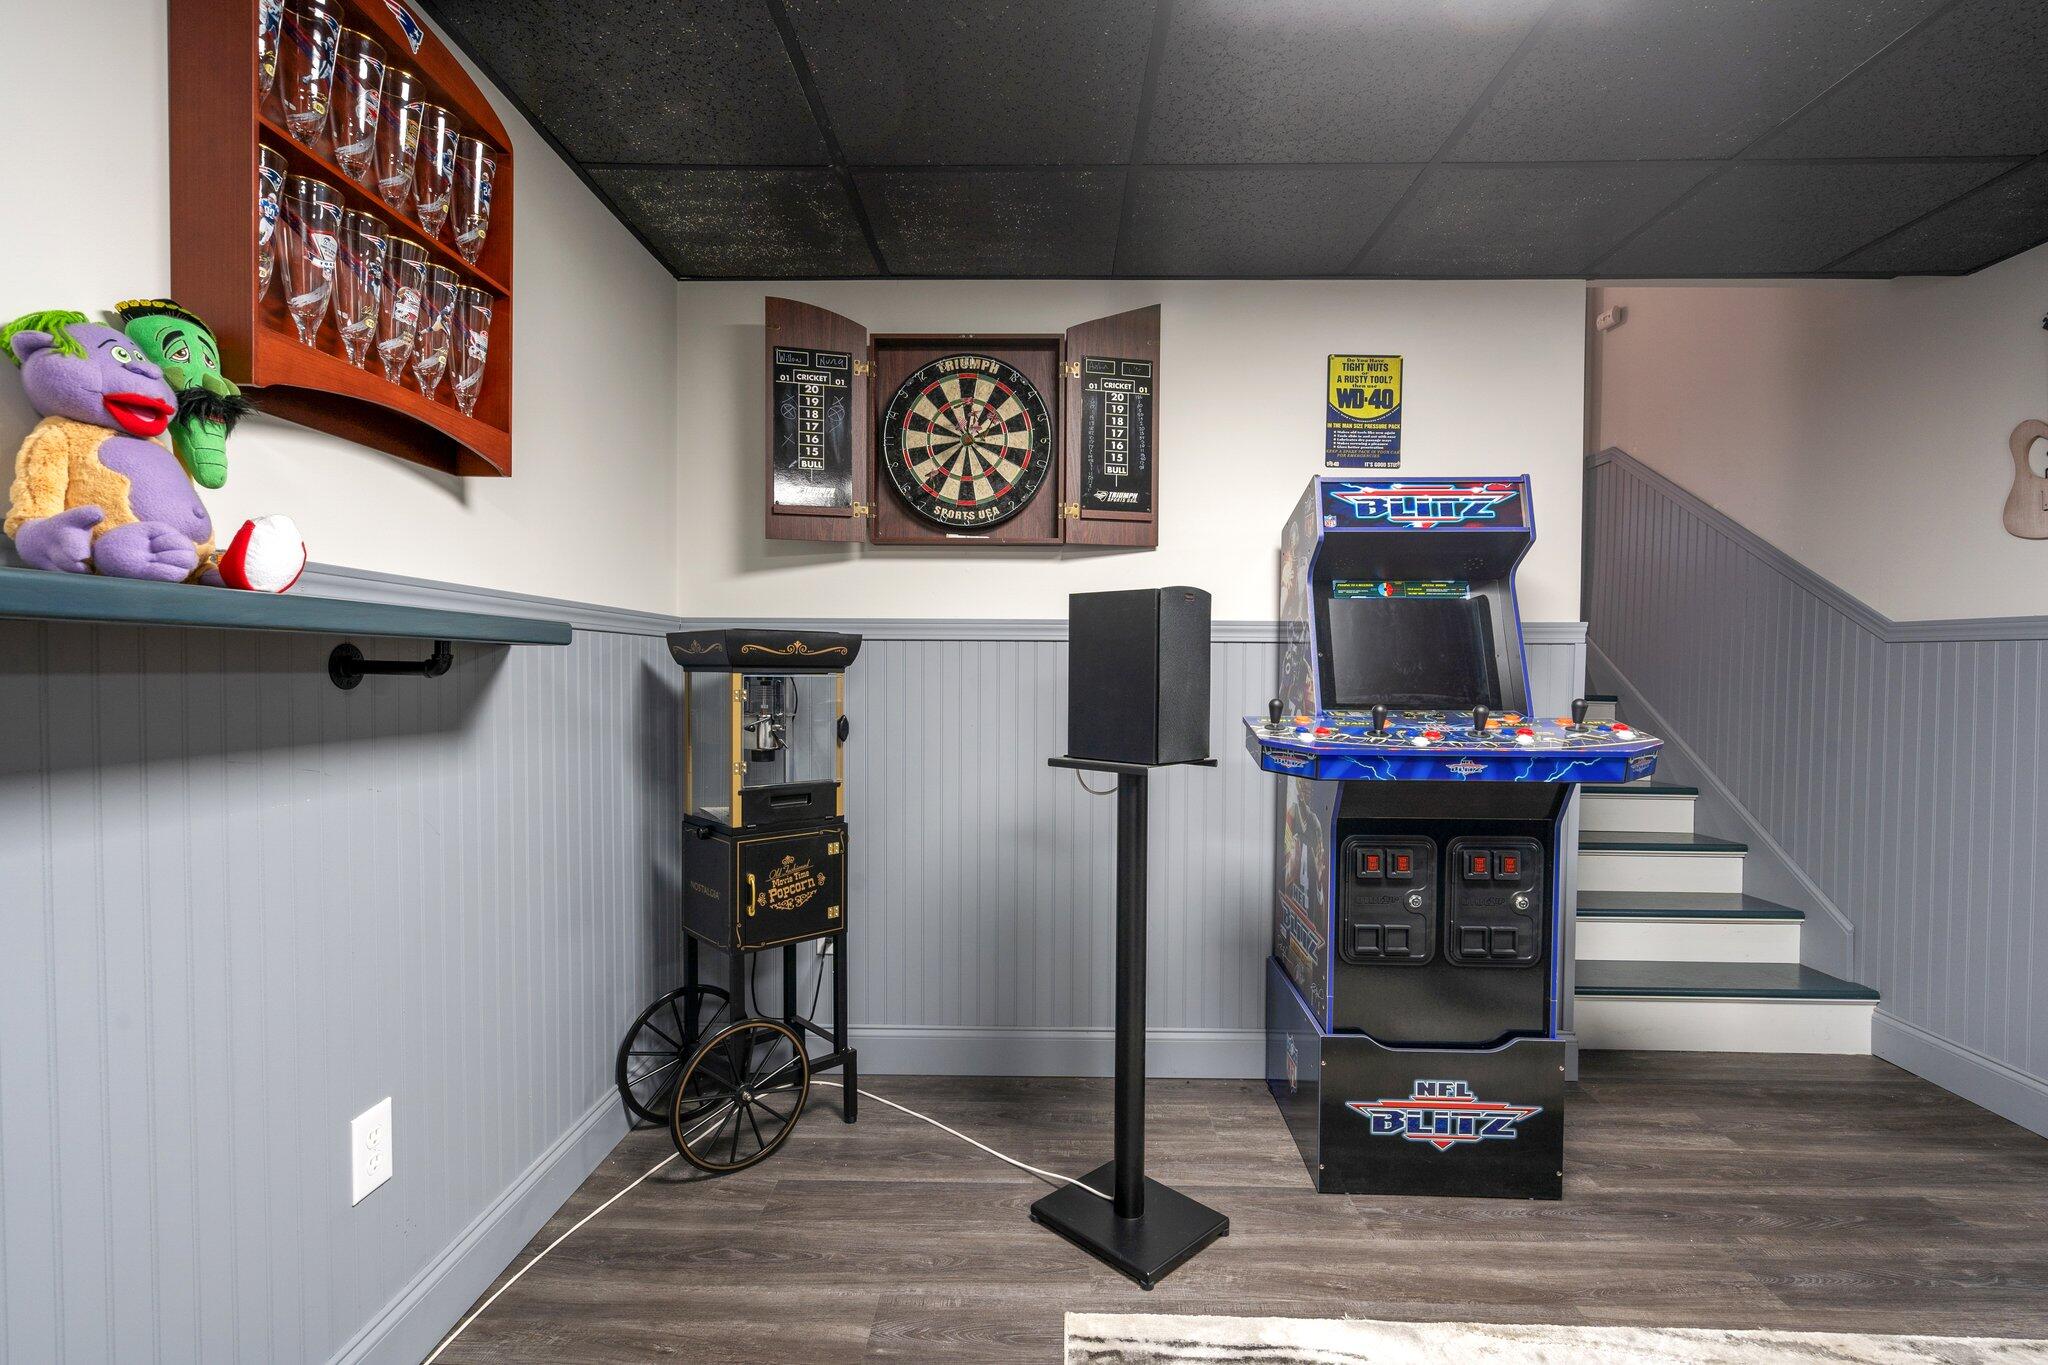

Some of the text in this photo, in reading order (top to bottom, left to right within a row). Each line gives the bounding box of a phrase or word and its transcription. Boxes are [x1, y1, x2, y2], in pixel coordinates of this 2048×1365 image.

[936, 358, 1000, 374] TRIUMPH
[1342, 362, 1389, 372] TIGHT NUTS
[796, 373, 828, 382] CRICKET
[835, 378, 845, 386] 01
[1336, 375, 1393, 384] A RUSTY TOOL?
[805, 385, 819, 394] 20
[1103, 381, 1132, 390] CRICKET
[805, 397, 819, 406] 19
[1111, 392, 1124, 402] 20
[1336, 387, 1394, 409] WD-40
[1111, 405, 1124, 413] 19
[805, 409, 819, 419] 18
[1111, 417, 1124, 426] 18
[805, 422, 819, 431] 17
[1111, 429, 1124, 438] 17
[805, 434, 819, 444] 16
[1111, 441, 1124, 450] 16
[805, 447, 819, 456] 15
[1111, 453, 1124, 462] 15
[801, 459, 823, 468] BULL
[1106, 466, 1127, 474] BULL
[1108, 491, 1138, 499] TRIUMPH
[1354, 495, 1495, 518] BLITZ
[933, 505, 1000, 520] SPORTS USA
[771, 871, 809, 888] Movie Time
[1415, 1081, 1473, 1098] NFL
[1368, 1109, 1517, 1139] BLITZ
